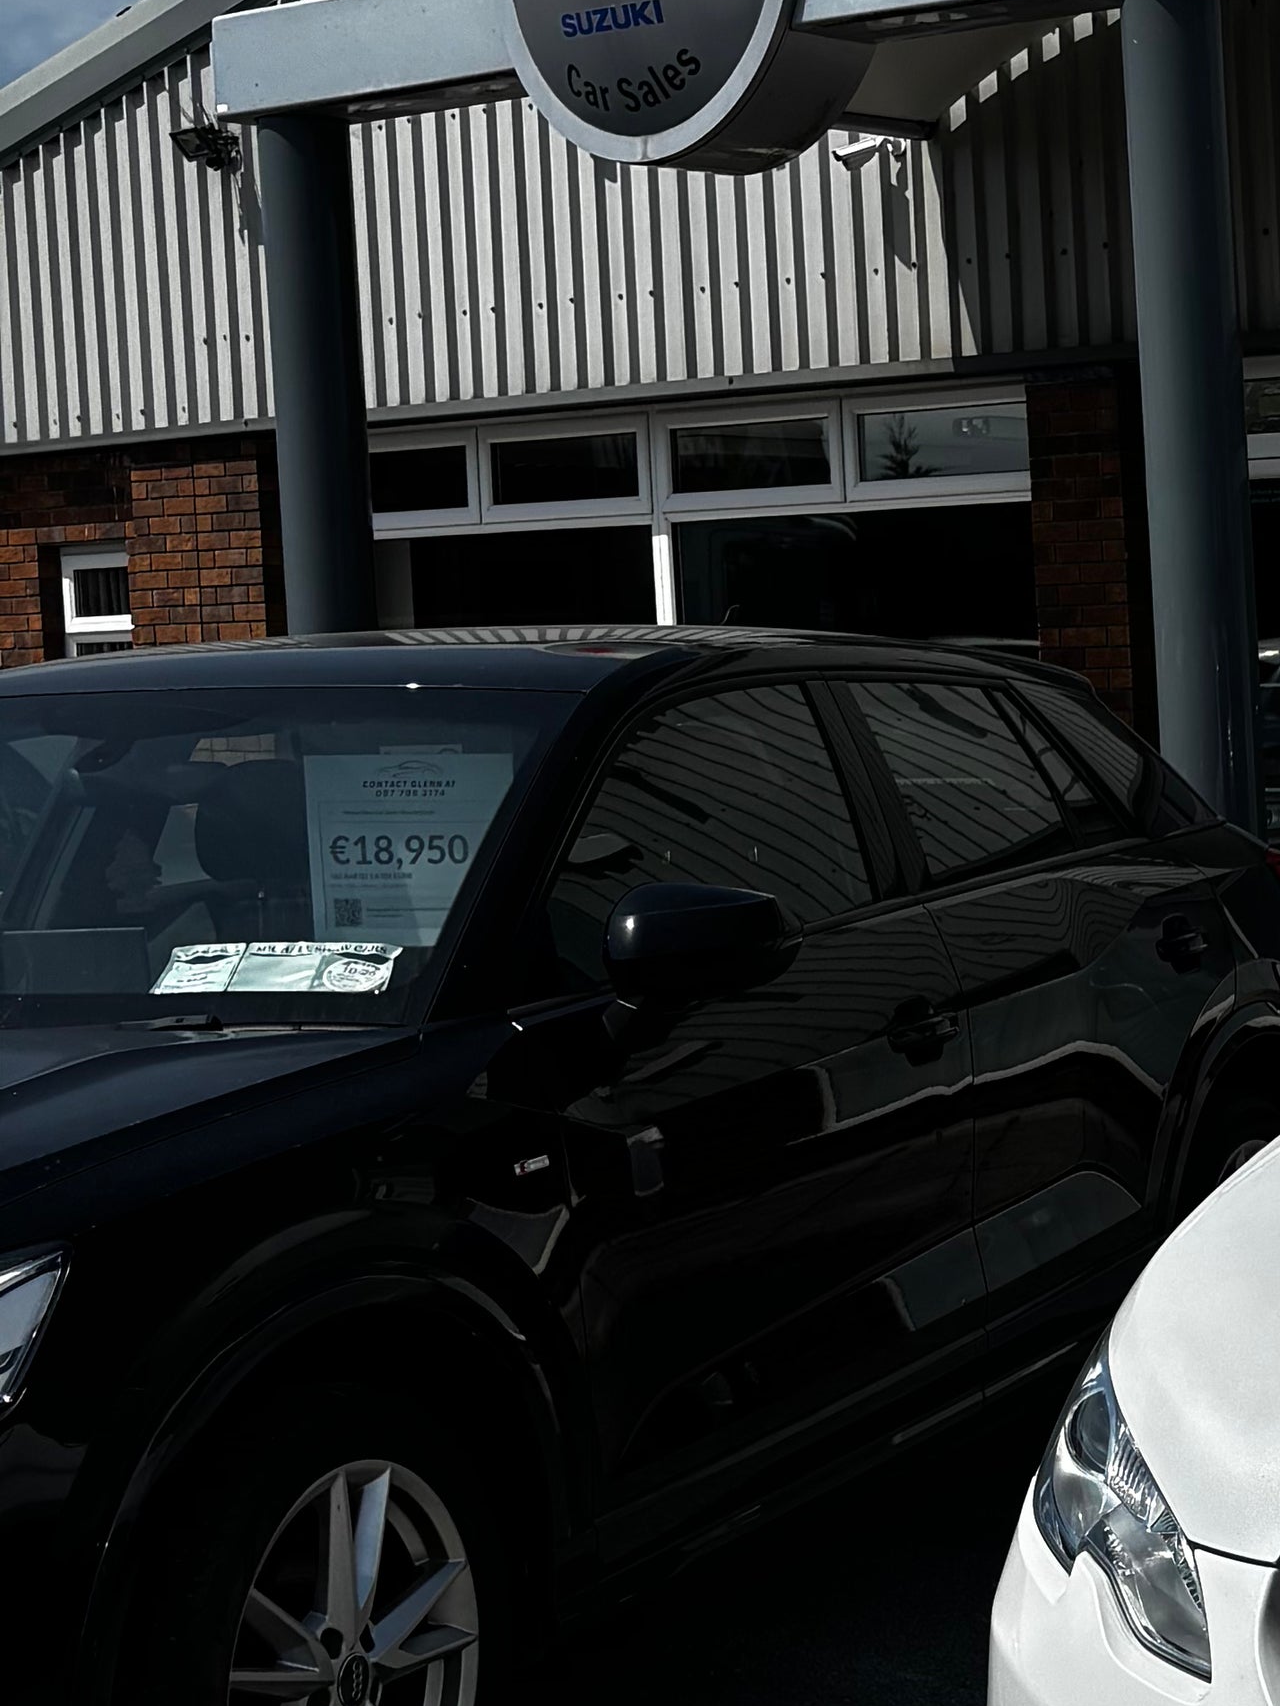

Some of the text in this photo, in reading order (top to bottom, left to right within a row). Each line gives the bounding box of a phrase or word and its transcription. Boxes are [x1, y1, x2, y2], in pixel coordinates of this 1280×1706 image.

[566, 47, 702, 113] Car Sales
[362, 780, 408, 789] CONTACT
[329, 834, 470, 869] €18,950
